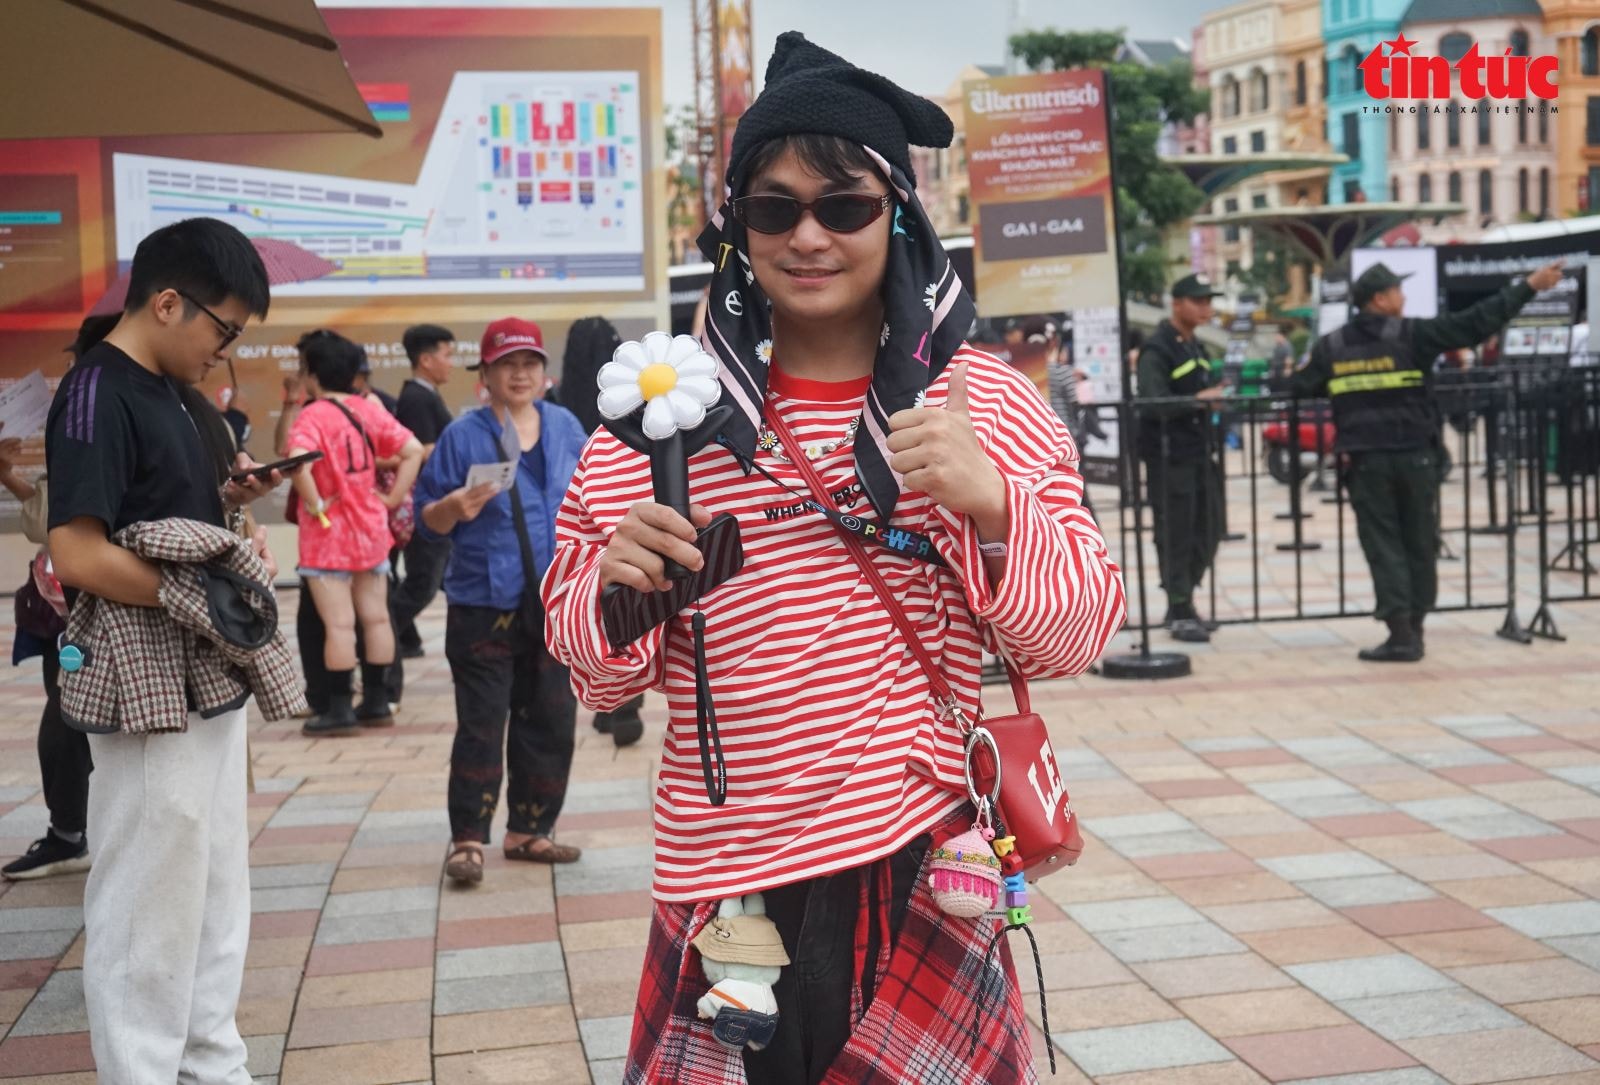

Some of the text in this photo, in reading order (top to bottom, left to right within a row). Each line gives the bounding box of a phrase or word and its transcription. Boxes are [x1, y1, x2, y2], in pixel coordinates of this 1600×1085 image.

[1054, 128, 1083, 142] CHO
[1002, 221, 1038, 238] GA1
[1047, 217, 1084, 235] GA4
[237, 344, 269, 359] QUY
